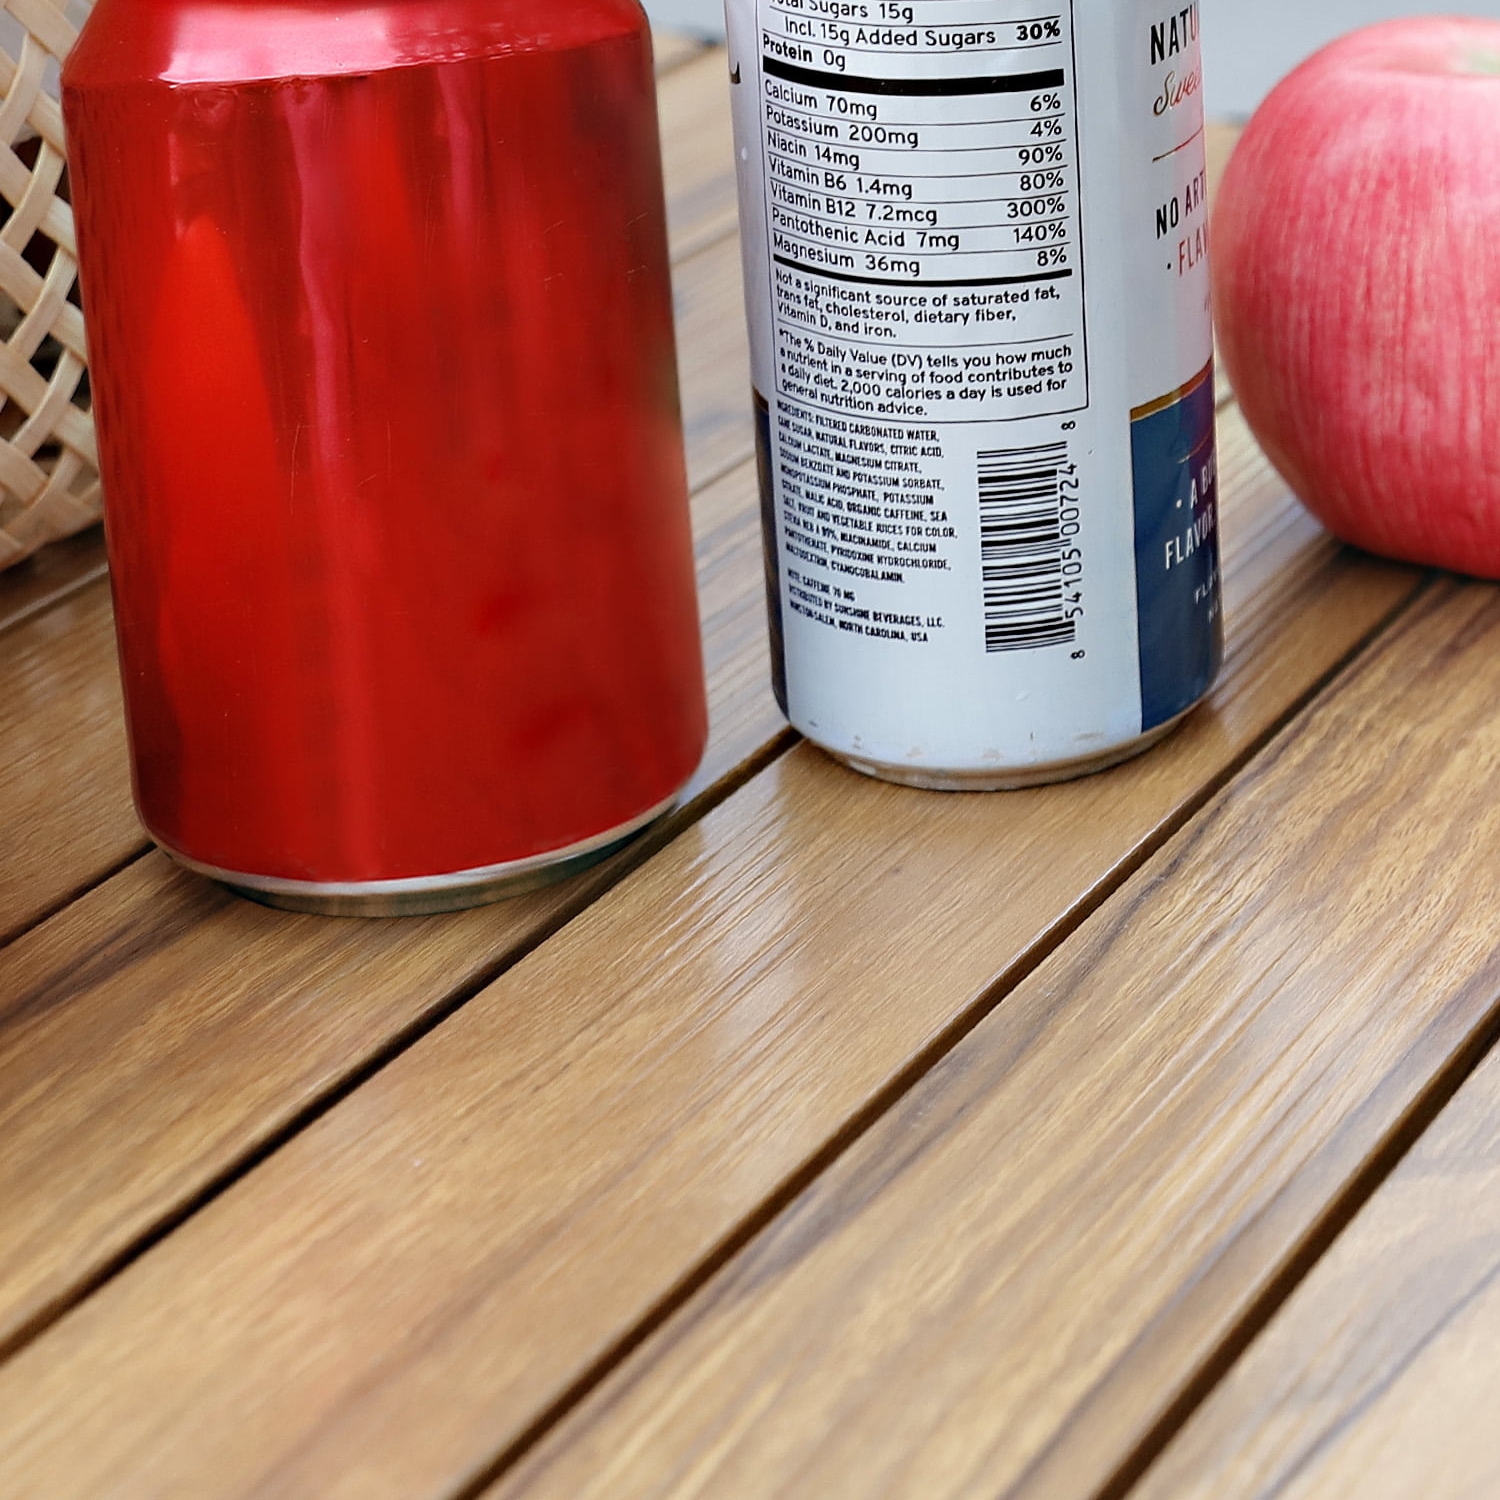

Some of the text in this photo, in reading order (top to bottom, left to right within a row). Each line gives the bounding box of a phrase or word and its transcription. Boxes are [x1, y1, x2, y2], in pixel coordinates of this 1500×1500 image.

[784, 16, 995, 47] Incl. 15g Added Sugars
[879, 3, 913, 23] 15g
[1016, 22, 1061, 41] 30%
[1150, 0, 1199, 65] NATU
[763, 34, 846, 71] Protein 0g
[764, 79, 877, 120] Calcium 70mg
[1030, 94, 1061, 112] 6%
[766, 105, 918, 147] Potassium 200mg
[1030, 120, 1062, 138] 4%
[767, 131, 860, 170] Niacin 14mg
[1018, 146, 1063, 165] 90%
[769, 156, 912, 199] Vitamin B6 1.4mg
[1019, 172, 1064, 191] 80%
[770, 180, 937, 225] Vitamin B12 7.2mcg
[1006, 198, 1065, 218] 300%
[1156, 197, 1178, 239] NO
[772, 207, 959, 251] Pantothenic Acid 7mg
[1013, 224, 1066, 244] 140%
[774, 233, 920, 276] Magnesium 36mg
[1037, 248, 1067, 267] 8%
[776, 269, 1060, 307] Not a significant source of saturated fat,
[777, 286, 1016, 325] trans fat, cholesterol, dietary fiber,
[778, 301, 897, 337] Vitamin D, and iron.
[780, 348, 1073, 386] a nutrient in a serving of food contributes to
[804, 338, 814, 352] %
[818, 342, 846, 362] Daily
[850, 349, 887, 364] Value
[891, 353, 922, 369] (DV)
[927, 356, 958, 368] tells
[963, 356, 991, 369] you
[996, 353, 1026, 365] how
[1032, 345, 1071, 361] much
[782, 364, 1067, 401] a daily diet. 2,000 calories a day is used for
[782, 379, 927, 415] general nutrition advice.
[1059, 463, 1080, 536] 00724
[1062, 548, 1083, 619] 54105
